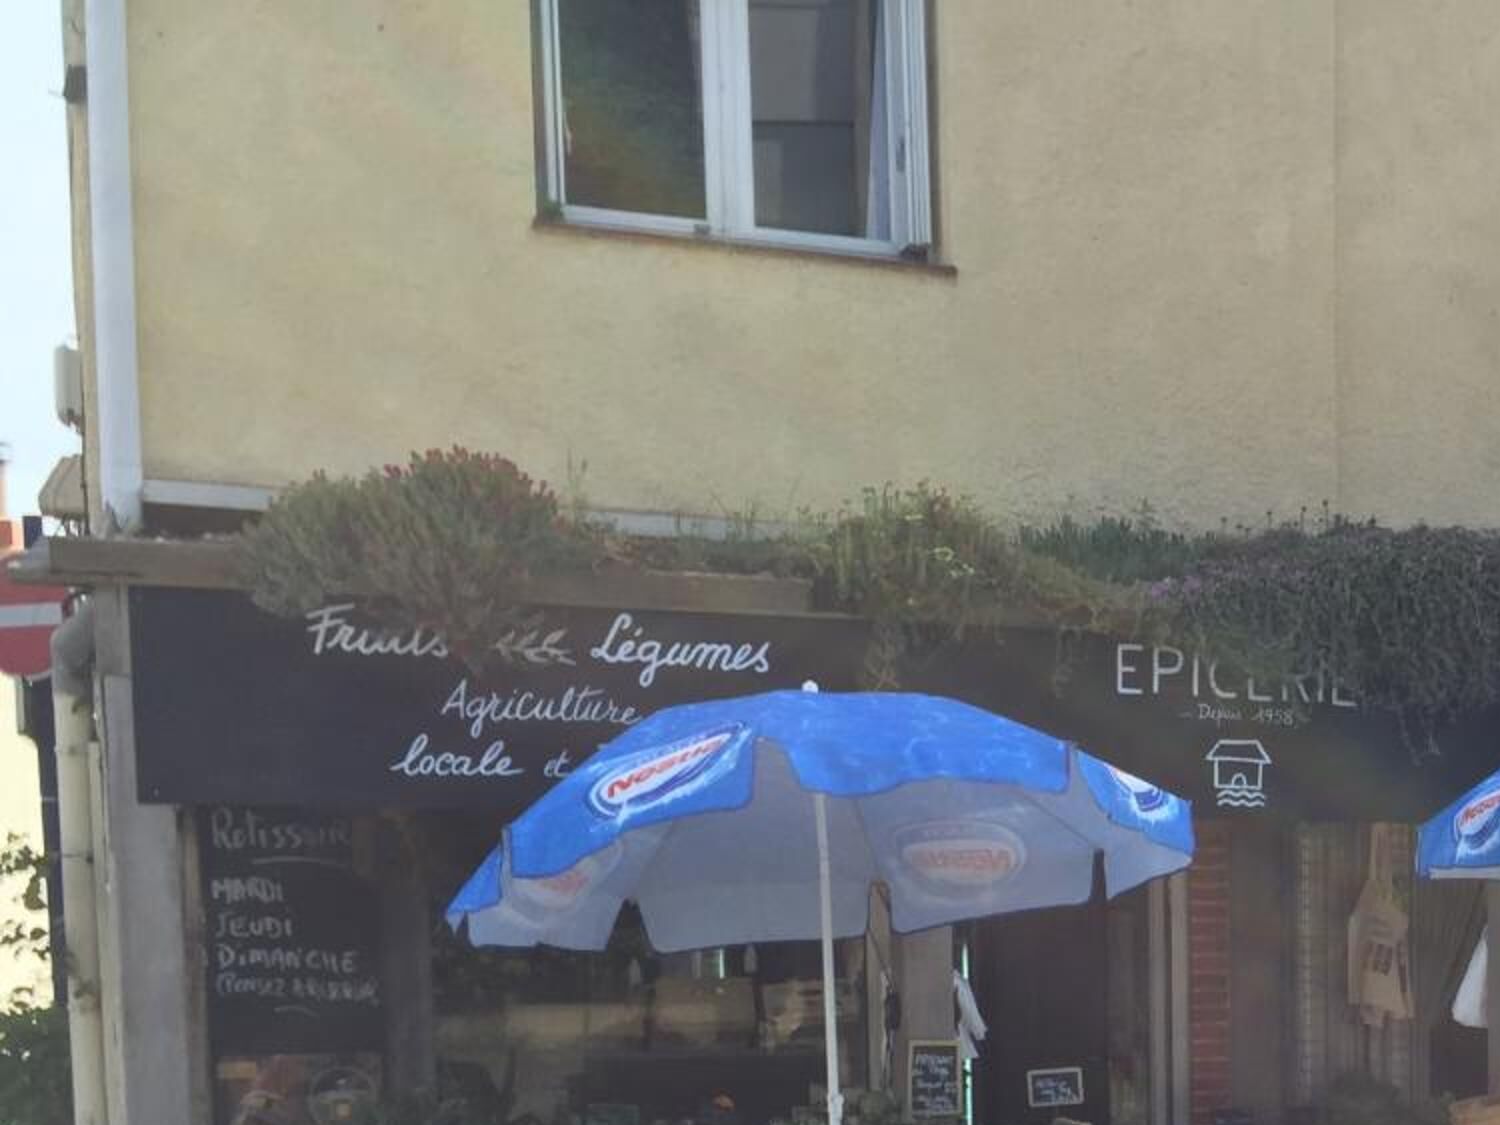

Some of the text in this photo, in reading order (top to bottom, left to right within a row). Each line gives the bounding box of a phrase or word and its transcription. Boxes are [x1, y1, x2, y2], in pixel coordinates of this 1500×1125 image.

[590, 612, 771, 687] Légumes
[440, 678, 642, 737] Agriculture
[390, 733, 525, 778] locale
[211, 877, 284, 904] MARDI
[216, 911, 292, 939] JEUDI
